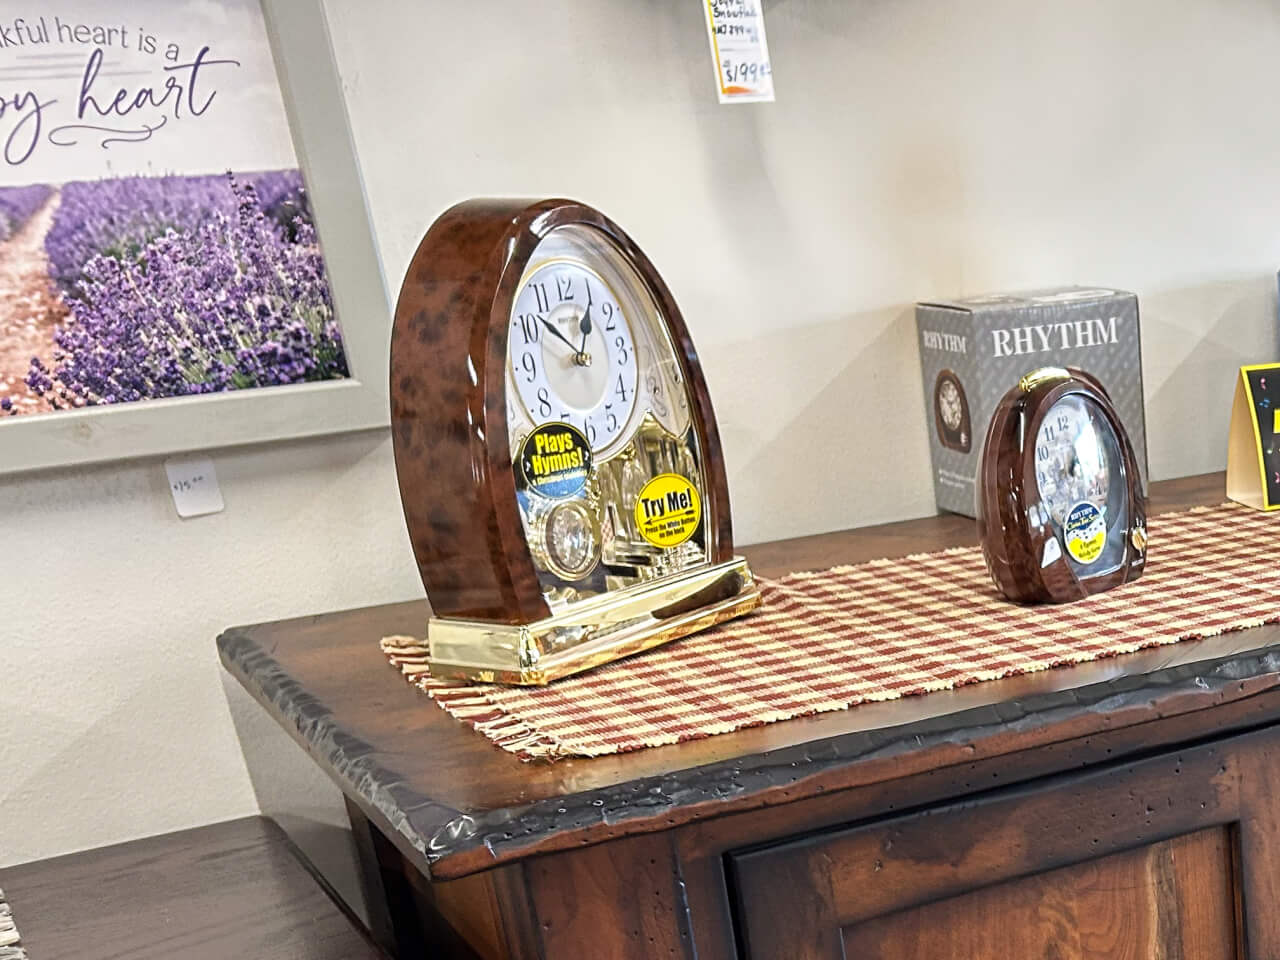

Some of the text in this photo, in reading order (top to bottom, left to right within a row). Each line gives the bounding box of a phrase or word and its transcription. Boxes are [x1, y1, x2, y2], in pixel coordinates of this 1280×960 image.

[0, 17, 179, 61] kful heart is a
[78, 47, 240, 119] heart
[532, 282, 550, 313] 11
[556, 276, 574, 301] 12
[520, 314, 539, 344] 10
[602, 302, 616, 331] 2
[616, 337, 628, 365] 3
[923, 330, 966, 353] RHYTHM
[991, 316, 1119, 358] RHYTHM
[522, 352, 536, 383] 9
[615, 372, 627, 402] 4
[537, 388, 551, 418] 8
[584, 416, 596, 448] 6
[605, 404, 617, 432] 5
[1057, 416, 1069, 432] 12
[535, 433, 573, 454] Plays
[1044, 425, 1055, 441] 11
[532, 447, 584, 475] Hymns!
[1037, 446, 1049, 461] 10
[641, 488, 693, 518] Try Me!
